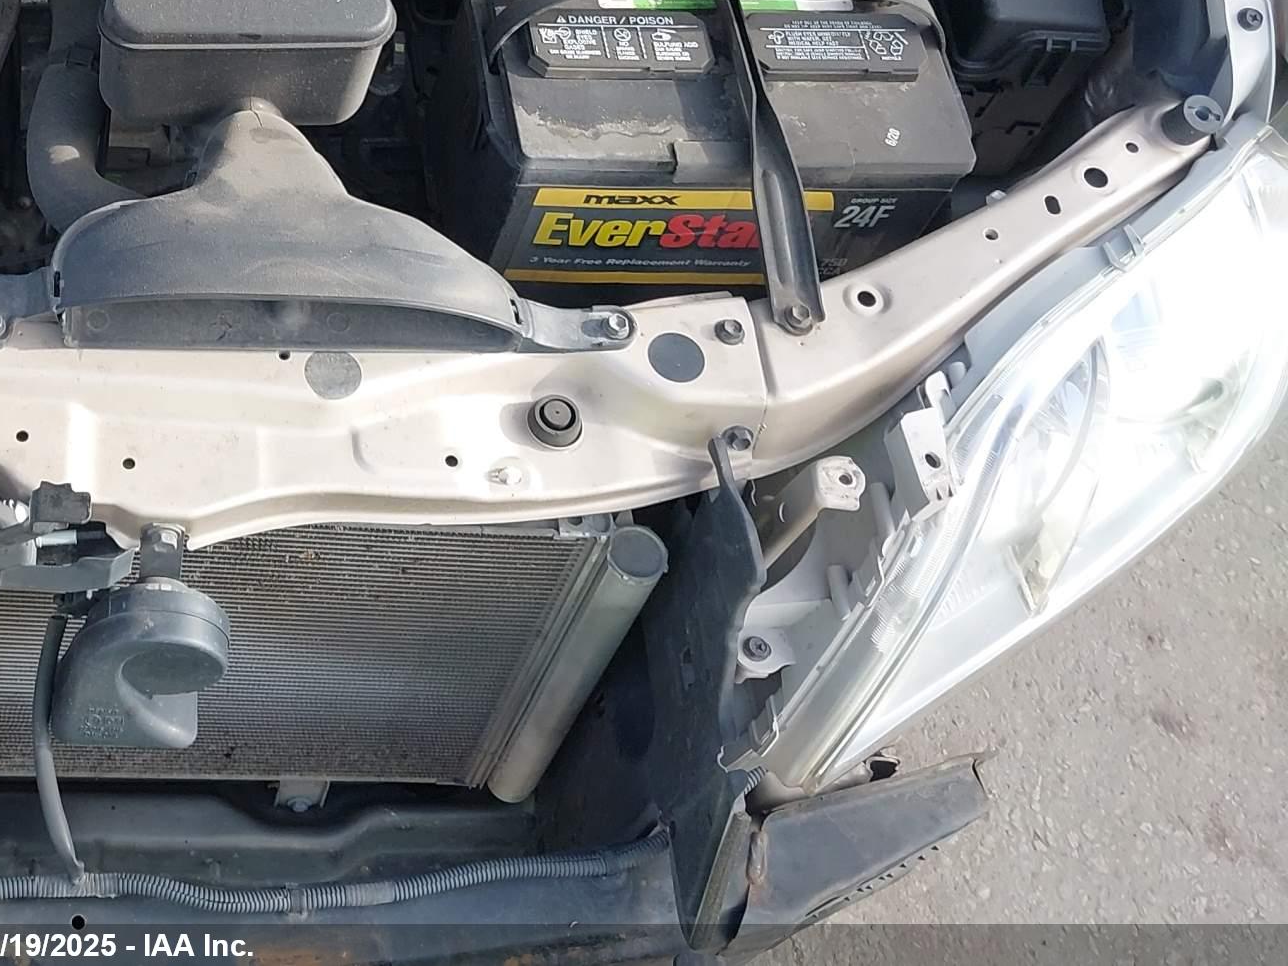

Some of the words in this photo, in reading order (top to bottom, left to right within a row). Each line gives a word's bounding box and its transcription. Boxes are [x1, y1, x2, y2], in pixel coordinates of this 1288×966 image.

[568, 15, 618, 25] DANGER
[629, 16, 674, 25] POISON
[584, 194, 680, 205] maxx
[833, 205, 896, 228] 24F
[532, 212, 760, 249] EverSta
[542, 257, 571, 265] Year
[573, 257, 602, 266] Free
[605, 258, 691, 266] Replacement
[694, 259, 751, 267] Warranty
